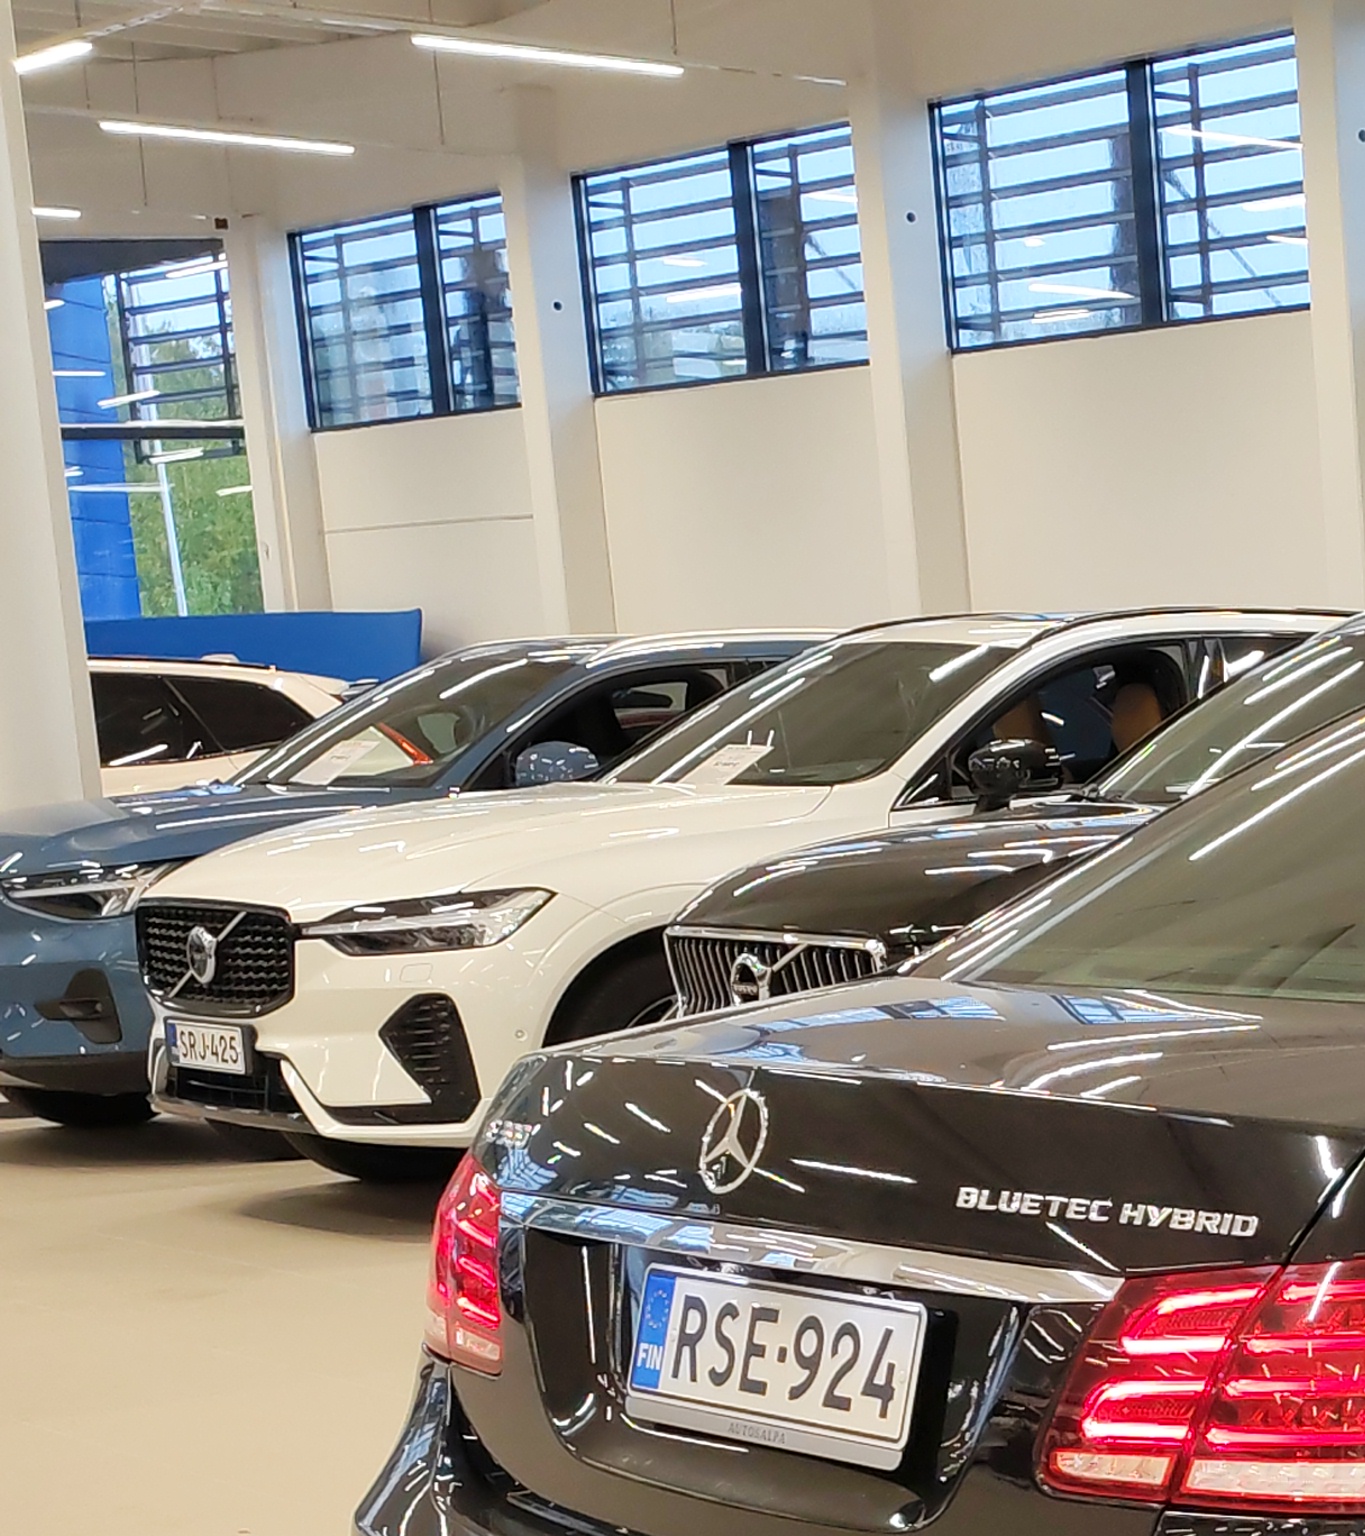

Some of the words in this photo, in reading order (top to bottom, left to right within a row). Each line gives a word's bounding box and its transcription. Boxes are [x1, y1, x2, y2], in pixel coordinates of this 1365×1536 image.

[179, 1030, 239, 1065] SRJ-425
[955, 1186, 1114, 1222] BLUETEC
[1118, 1202, 1260, 1238] HYBRID
[636, 1342, 663, 1370] FIN
[669, 1294, 897, 1419] RSE-924
[727, 1421, 787, 1445] AUTOSALPA
